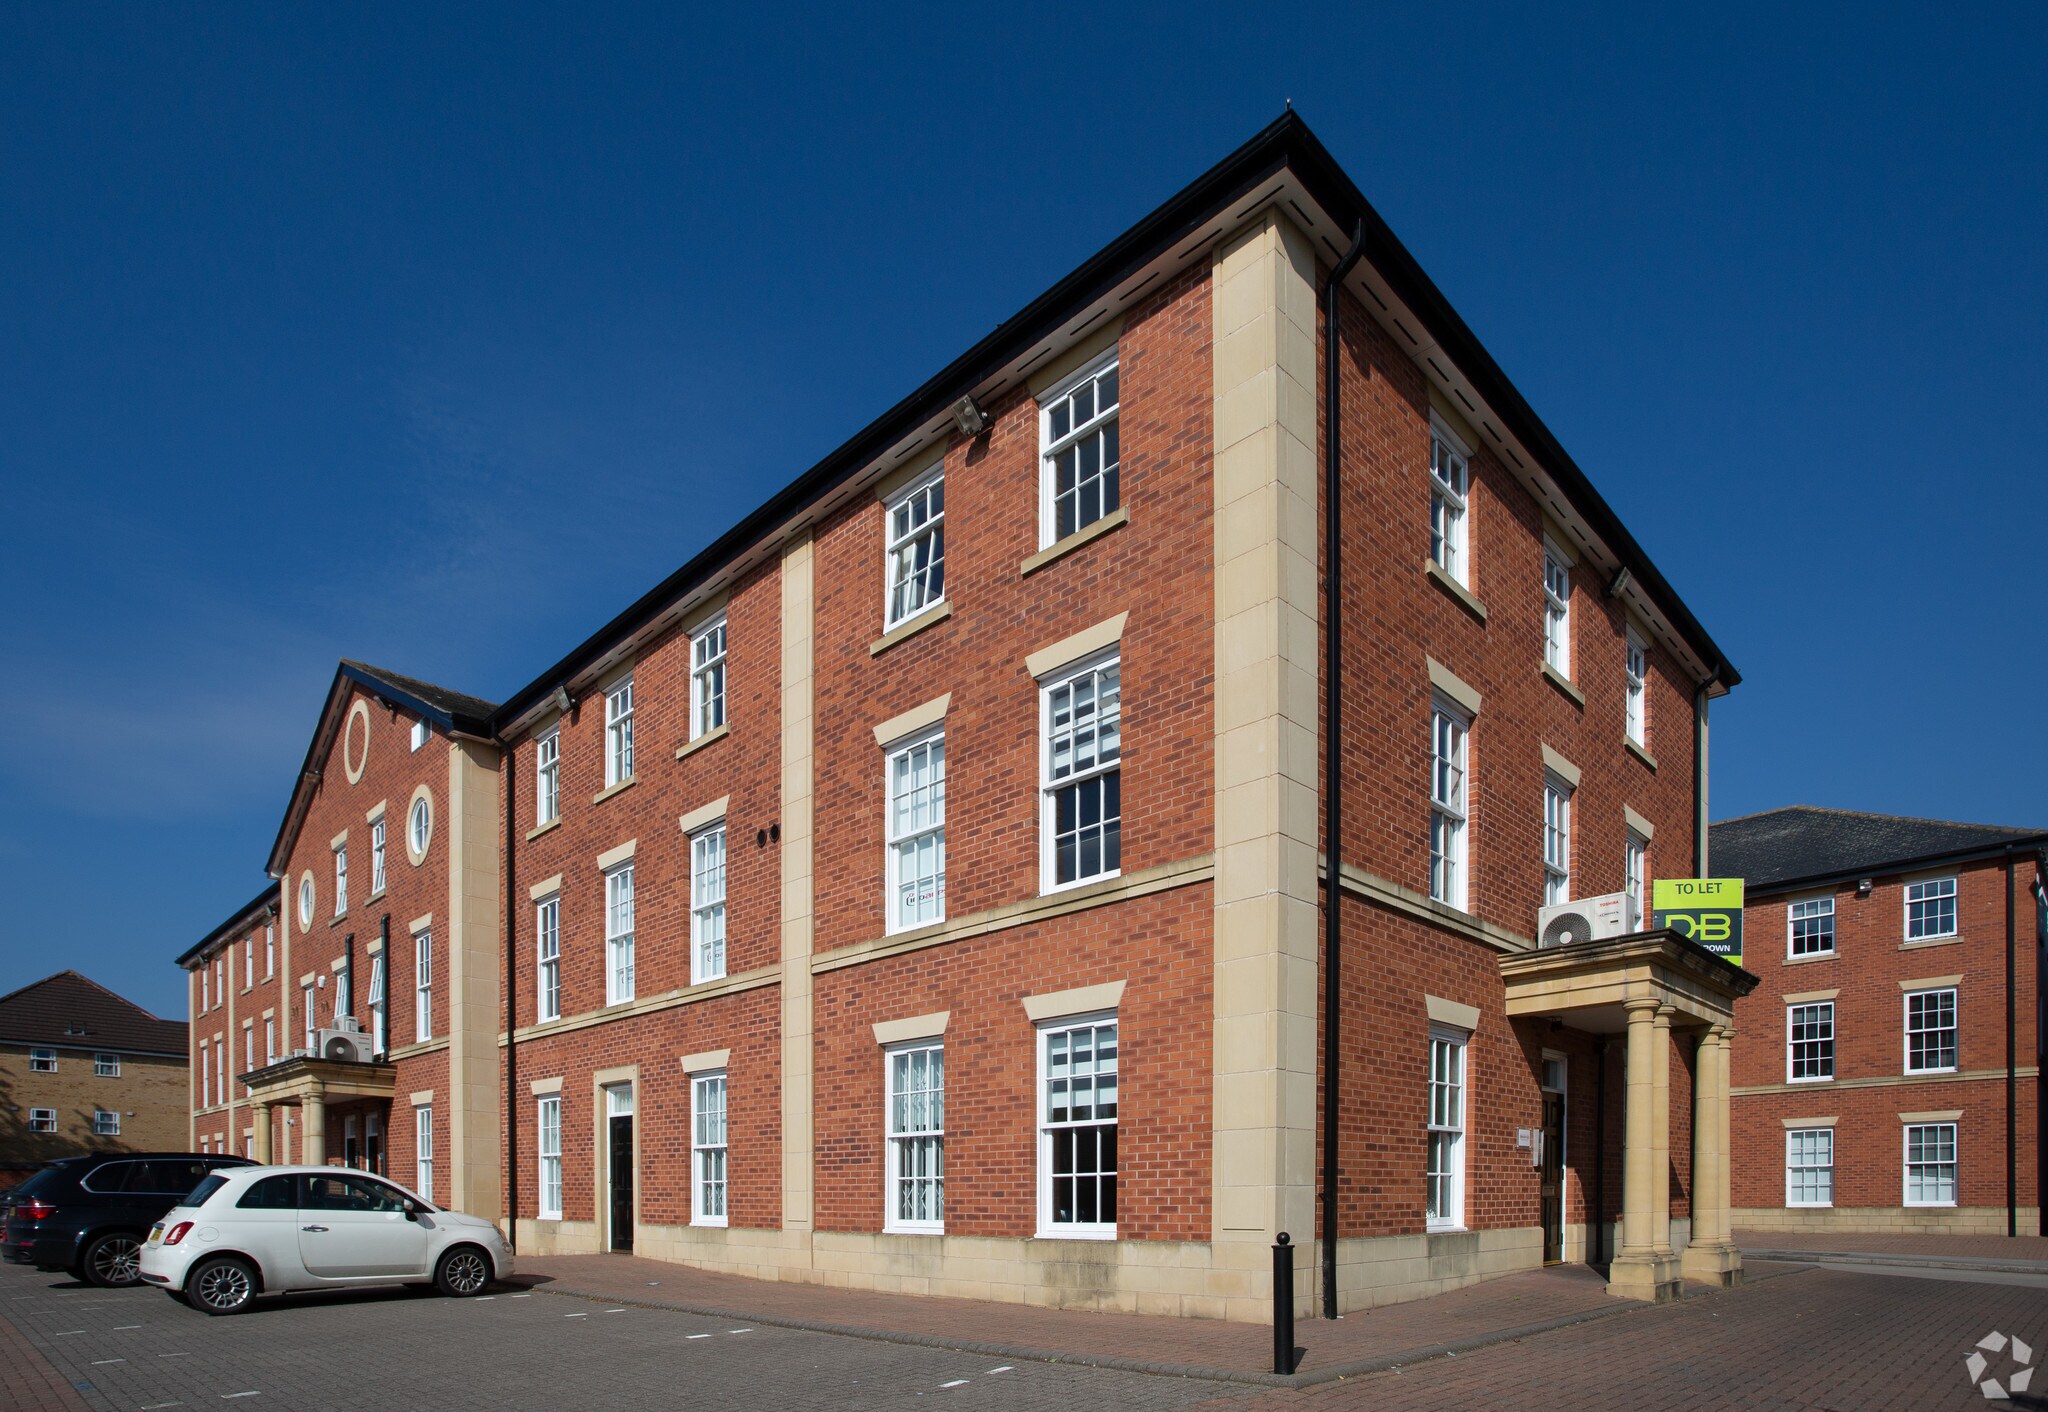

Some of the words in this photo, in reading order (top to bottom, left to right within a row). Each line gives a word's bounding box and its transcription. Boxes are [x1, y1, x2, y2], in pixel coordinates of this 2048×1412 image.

[1675, 883, 1694, 895] TO
[1698, 882, 1722, 894] LET
[1665, 913, 1731, 941] DB
